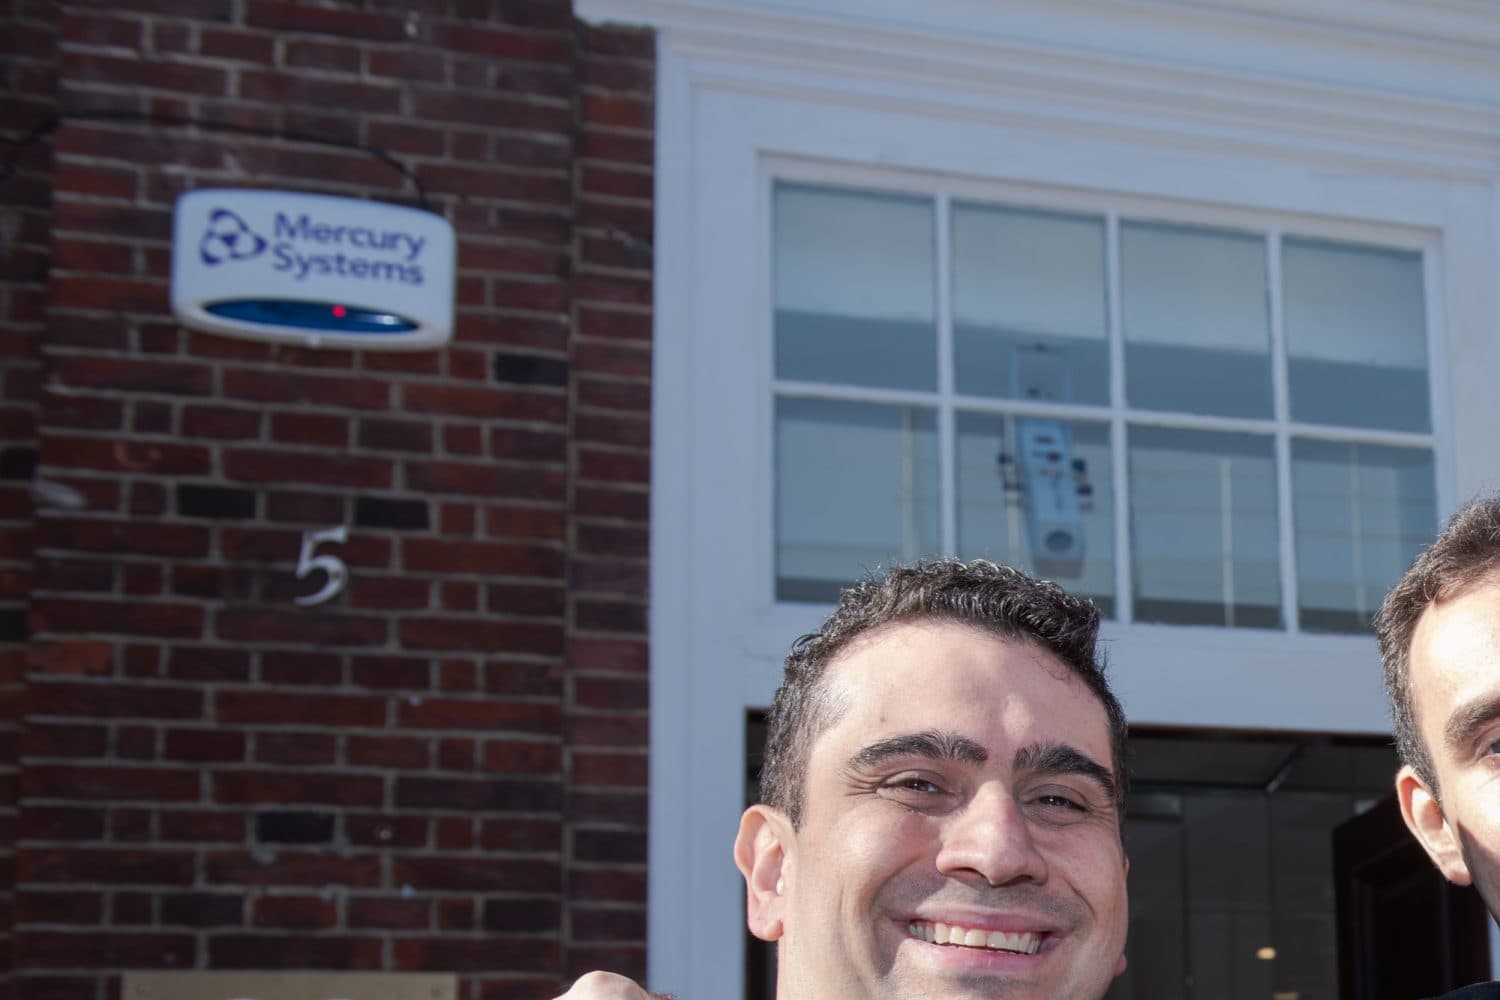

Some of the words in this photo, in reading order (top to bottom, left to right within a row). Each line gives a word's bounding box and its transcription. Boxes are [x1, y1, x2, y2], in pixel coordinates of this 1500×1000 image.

[273, 211, 427, 261] Mercury
[272, 244, 425, 285] Systems
[294, 525, 348, 606] 5
